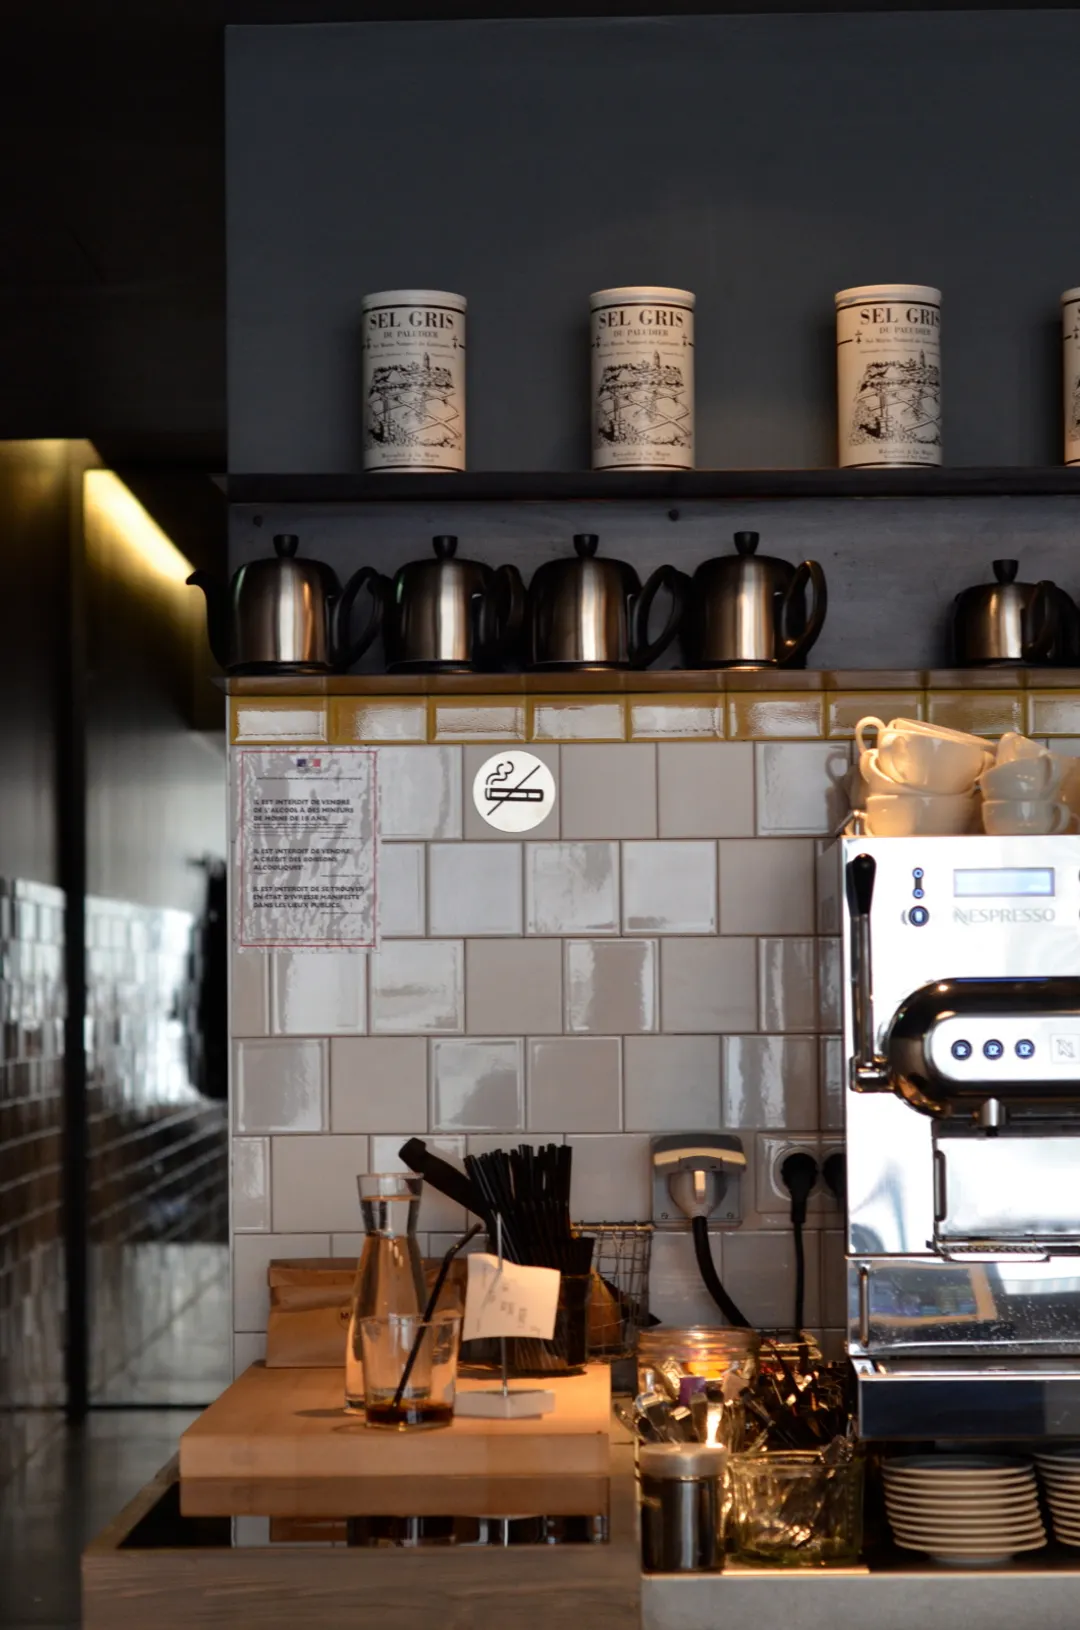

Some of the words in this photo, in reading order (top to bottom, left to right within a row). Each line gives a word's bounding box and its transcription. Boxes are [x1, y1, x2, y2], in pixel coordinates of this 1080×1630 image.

[369, 311, 400, 330] SEL
[409, 311, 454, 330] GRIS
[599, 310, 631, 329] SEL
[639, 309, 684, 328] GRIS
[860, 307, 898, 325] SEL
[953, 905, 1055, 925] NESPRESSO
